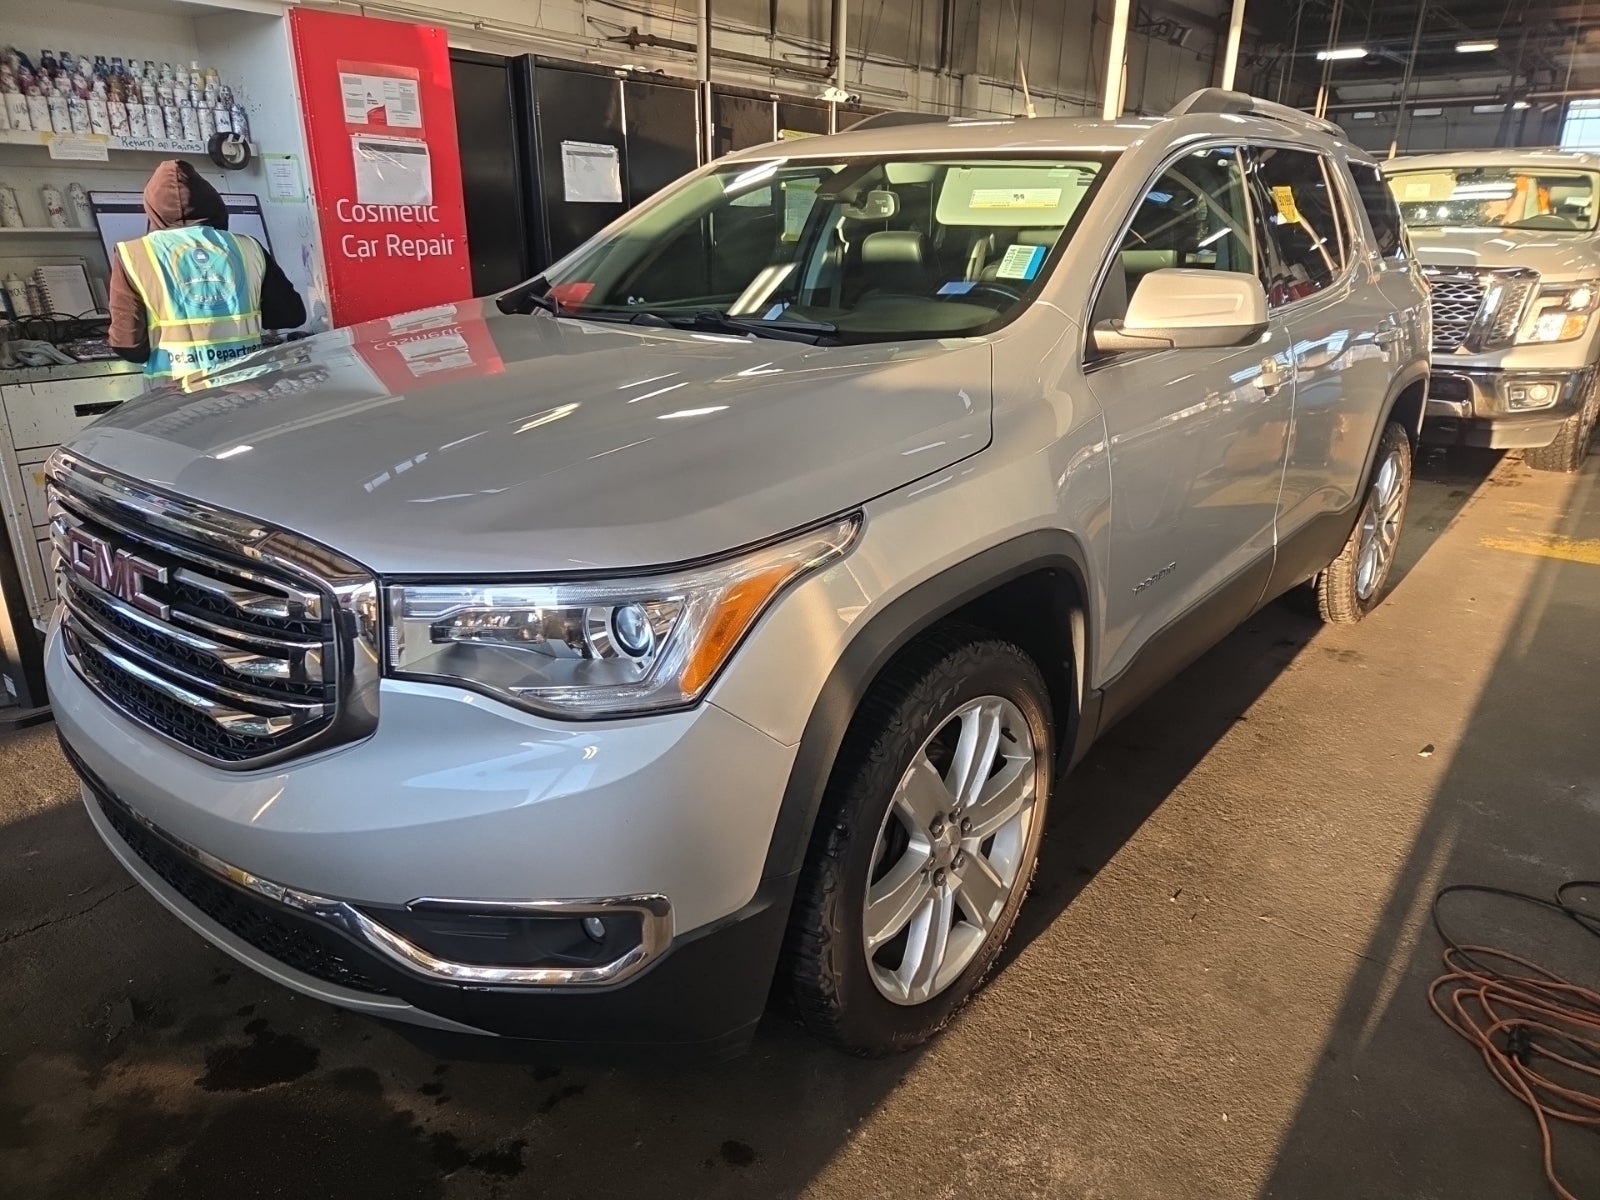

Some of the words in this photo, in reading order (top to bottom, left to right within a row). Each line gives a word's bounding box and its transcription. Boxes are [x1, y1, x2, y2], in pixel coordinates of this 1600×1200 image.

[121, 137, 155, 148] Return
[336, 198, 440, 223] Cosmetic
[341, 234, 379, 258] Car
[385, 233, 455, 261] Repair
[167, 350, 203, 364] Detail
[206, 344, 263, 362] Departme
[68, 527, 170, 621] GMC
